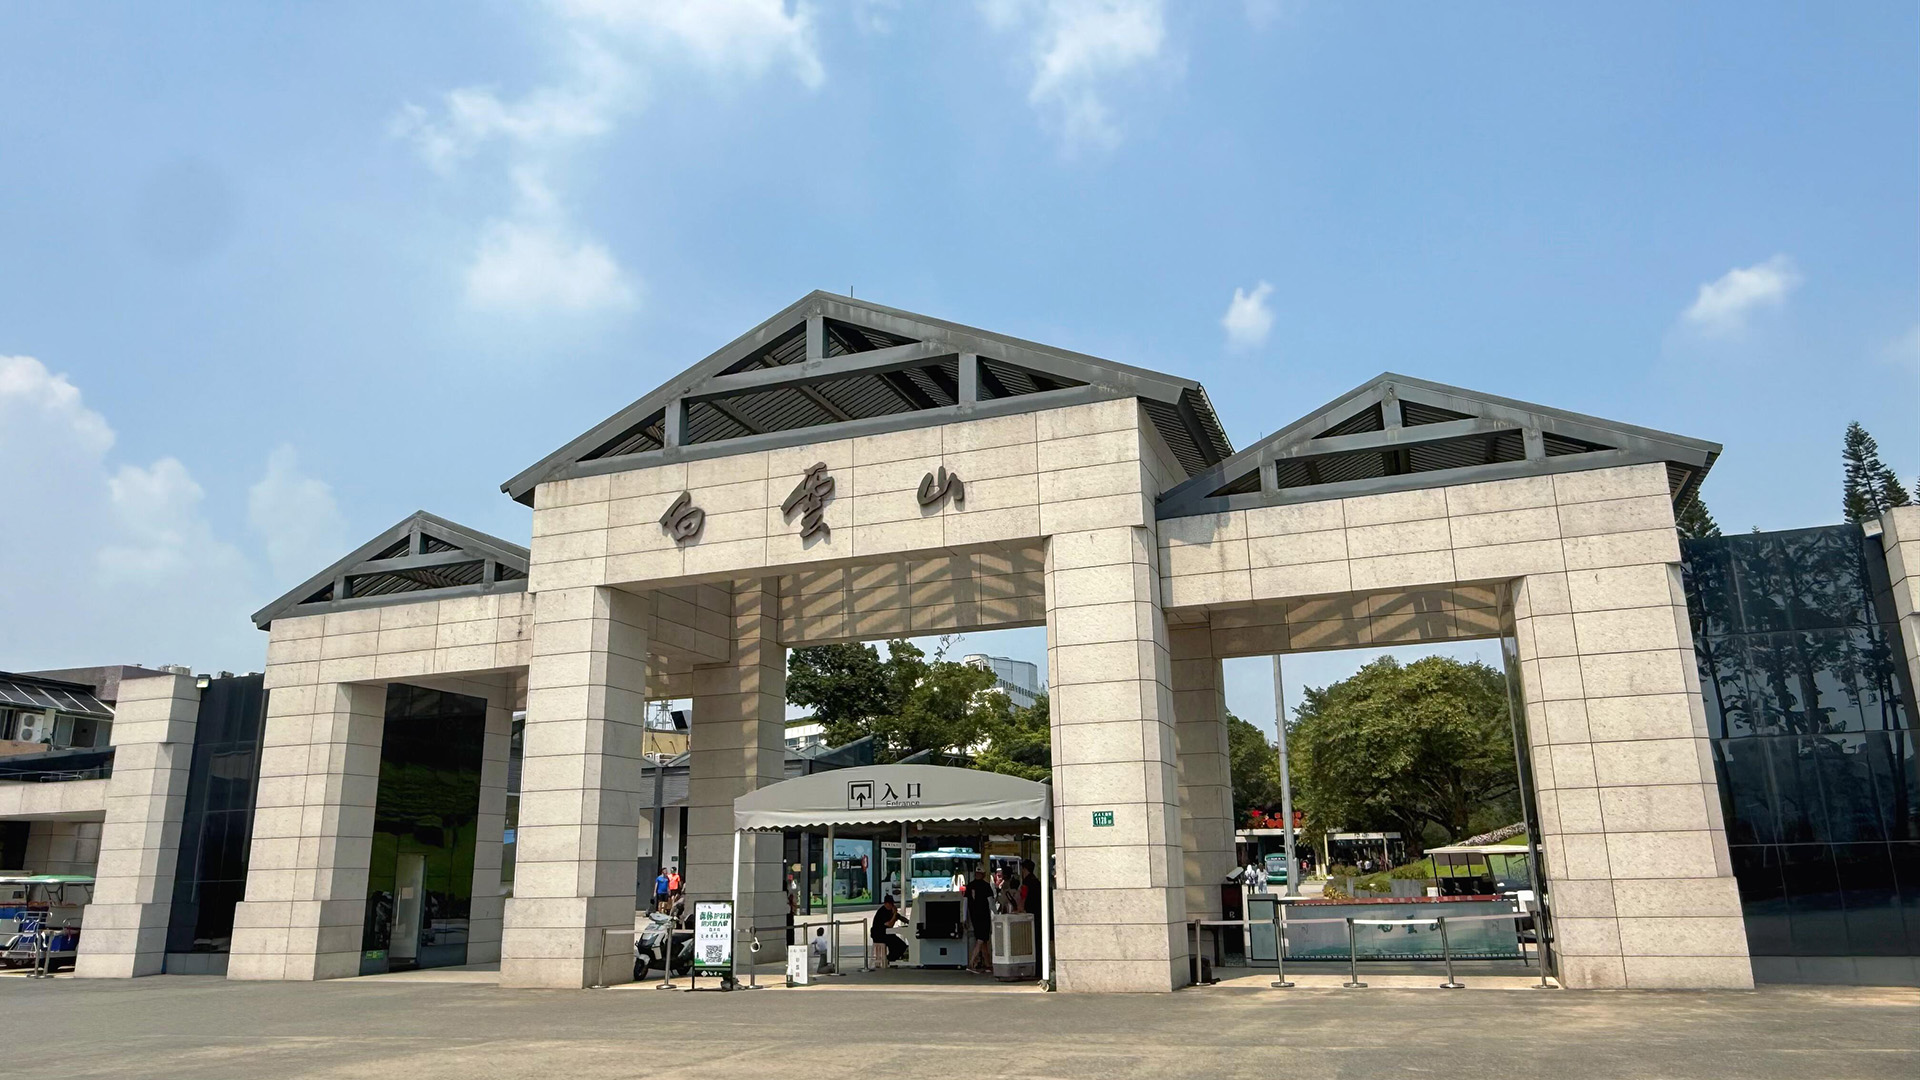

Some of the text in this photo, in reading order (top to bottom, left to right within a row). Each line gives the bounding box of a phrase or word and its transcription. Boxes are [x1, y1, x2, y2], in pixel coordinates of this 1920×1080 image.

[659, 462, 965, 541] 白雲山
[881, 783, 921, 801] 入口
